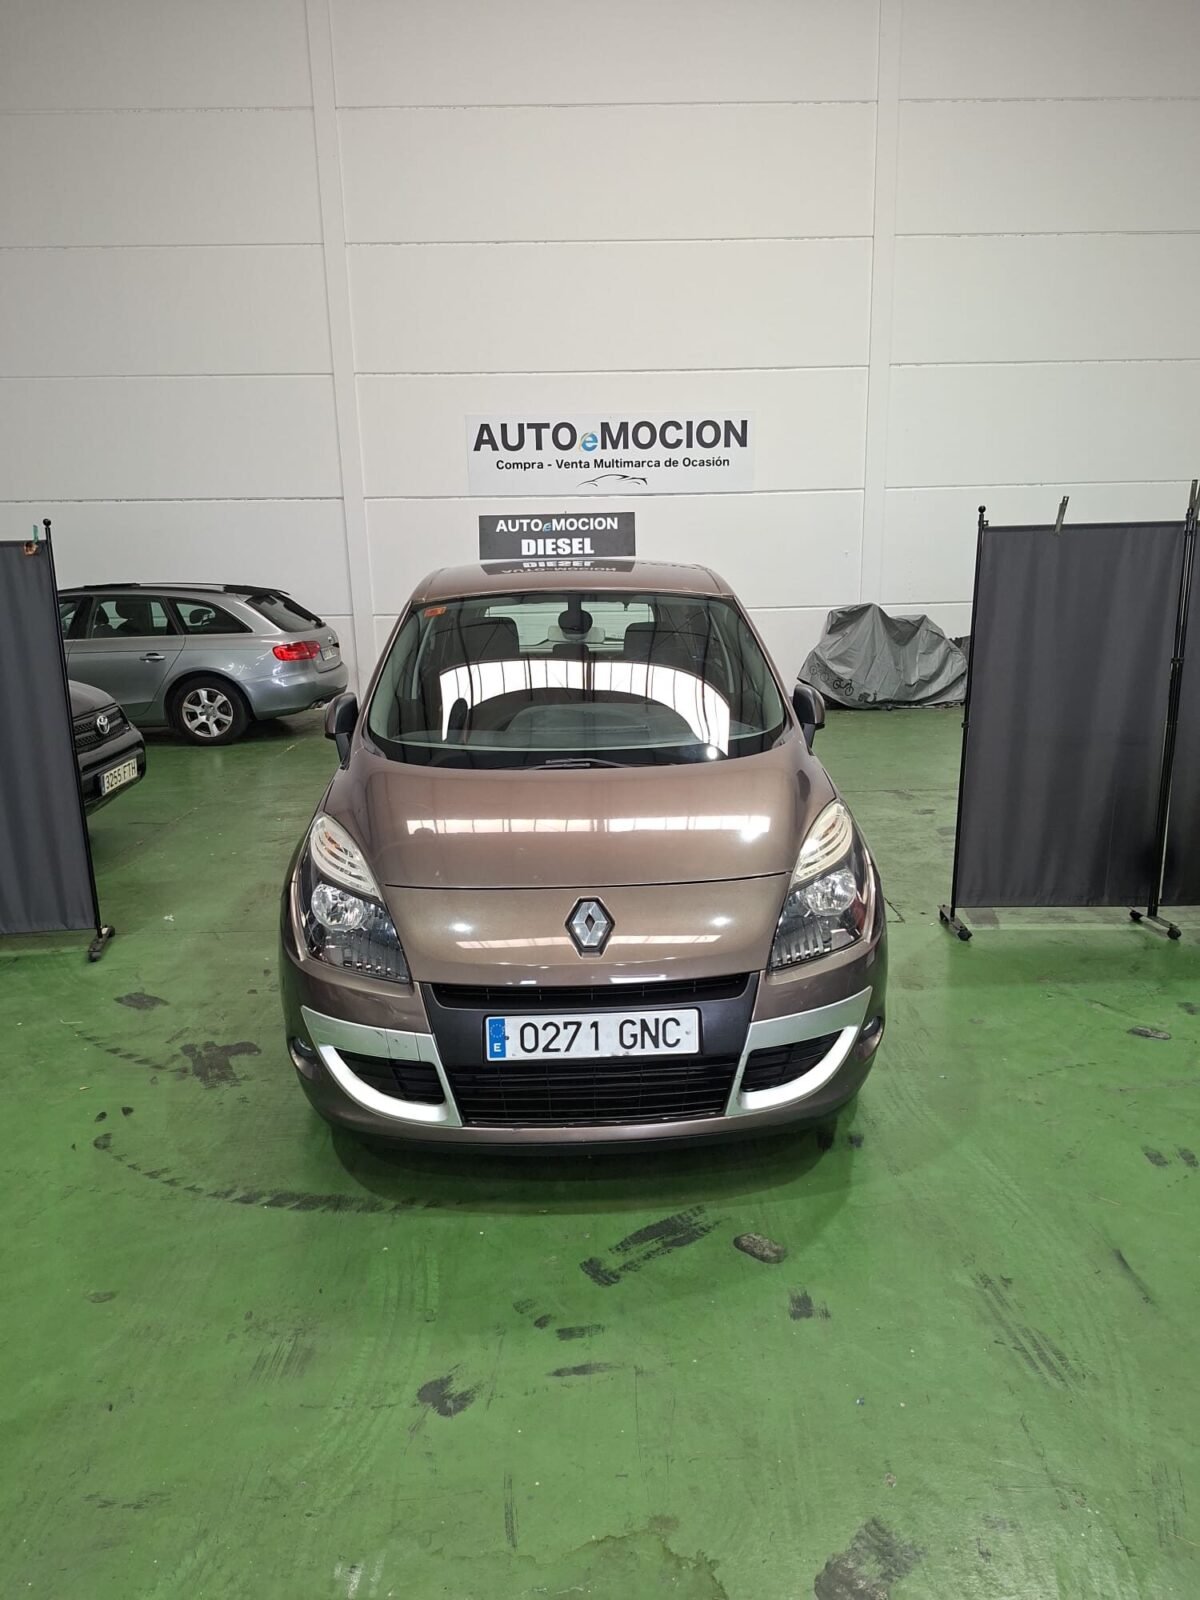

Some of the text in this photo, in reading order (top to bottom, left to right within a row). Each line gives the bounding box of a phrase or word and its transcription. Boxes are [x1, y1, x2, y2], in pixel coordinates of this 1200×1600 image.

[473, 420, 748, 452] AUTOeMOCION
[496, 460, 544, 471] Compra
[556, 459, 590, 469] Venta
[594, 458, 660, 469] Multimarca
[664, 458, 679, 468] de
[682, 456, 730, 468] Ocasión
[521, 537, 595, 556] DIESEL
[519, 1017, 681, 1053] 0271 GNC
[494, 1043, 502, 1052] E
